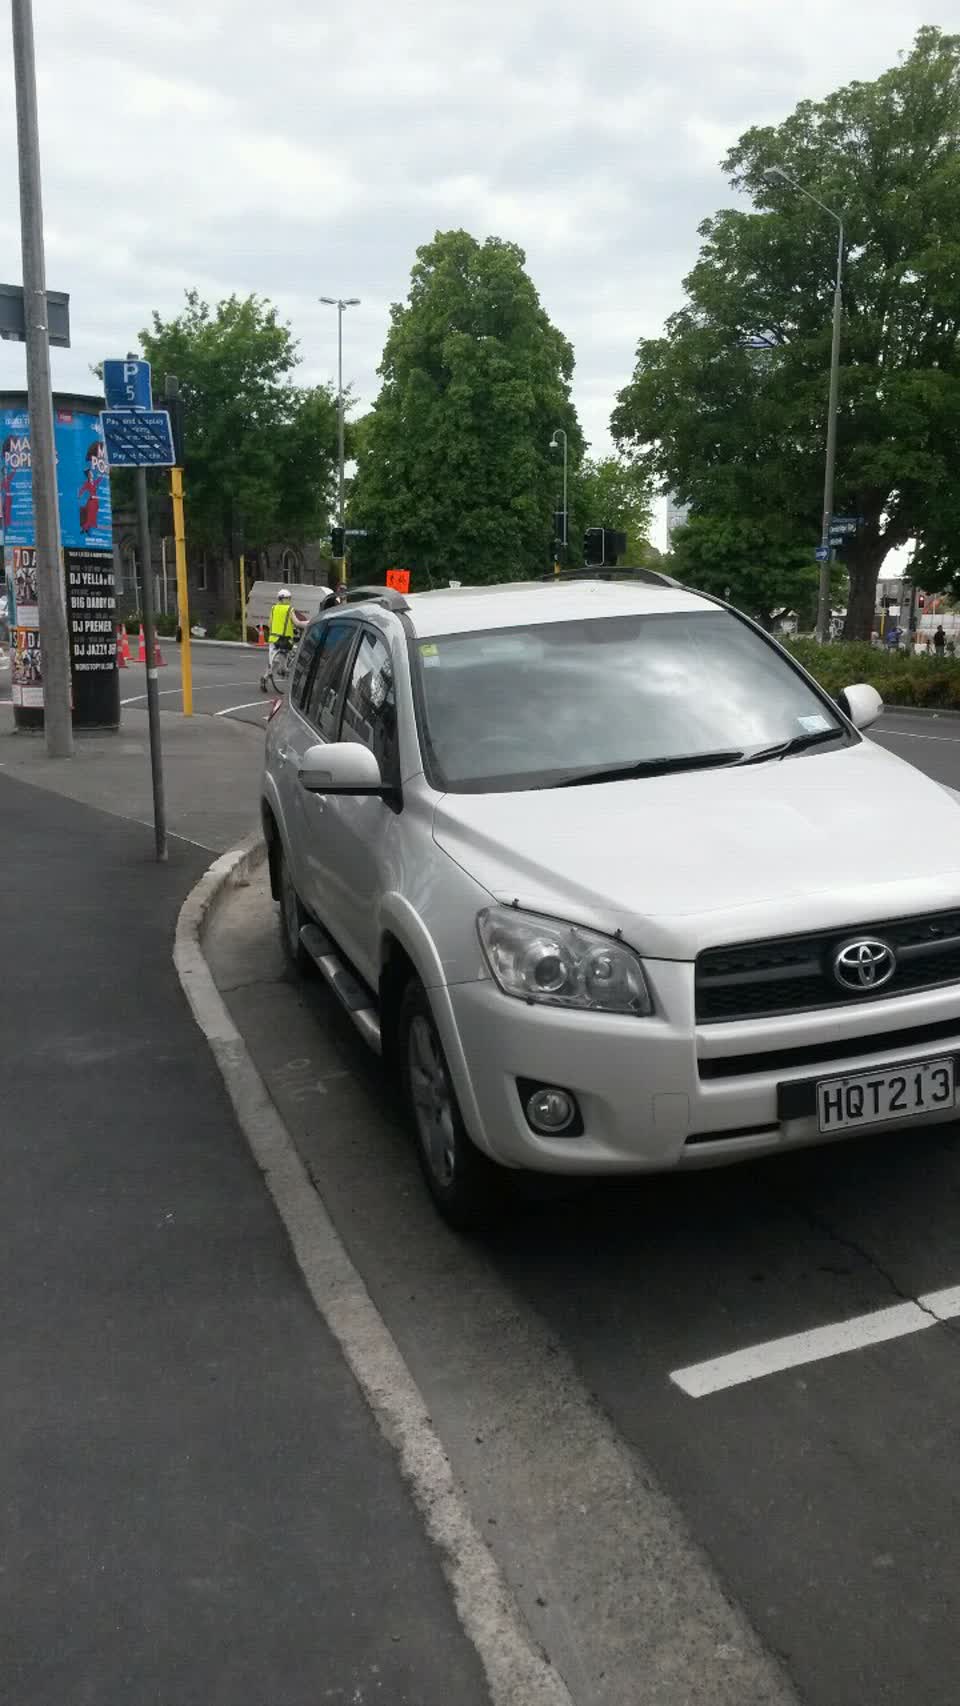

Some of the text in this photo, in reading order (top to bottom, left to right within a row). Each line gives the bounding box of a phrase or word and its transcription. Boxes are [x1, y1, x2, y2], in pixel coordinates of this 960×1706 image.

[123, 363, 139, 383] P
[126, 385, 135, 400] 5
[70, 573, 81, 584] DJ
[82, 573, 103, 585] YELLA
[71, 597, 84, 608] BIG
[72, 621, 83, 632] DJ
[74, 644, 85, 656] DJ
[86, 644, 107, 656] JAZZY
[823, 1068, 950, 1124] HQT213
